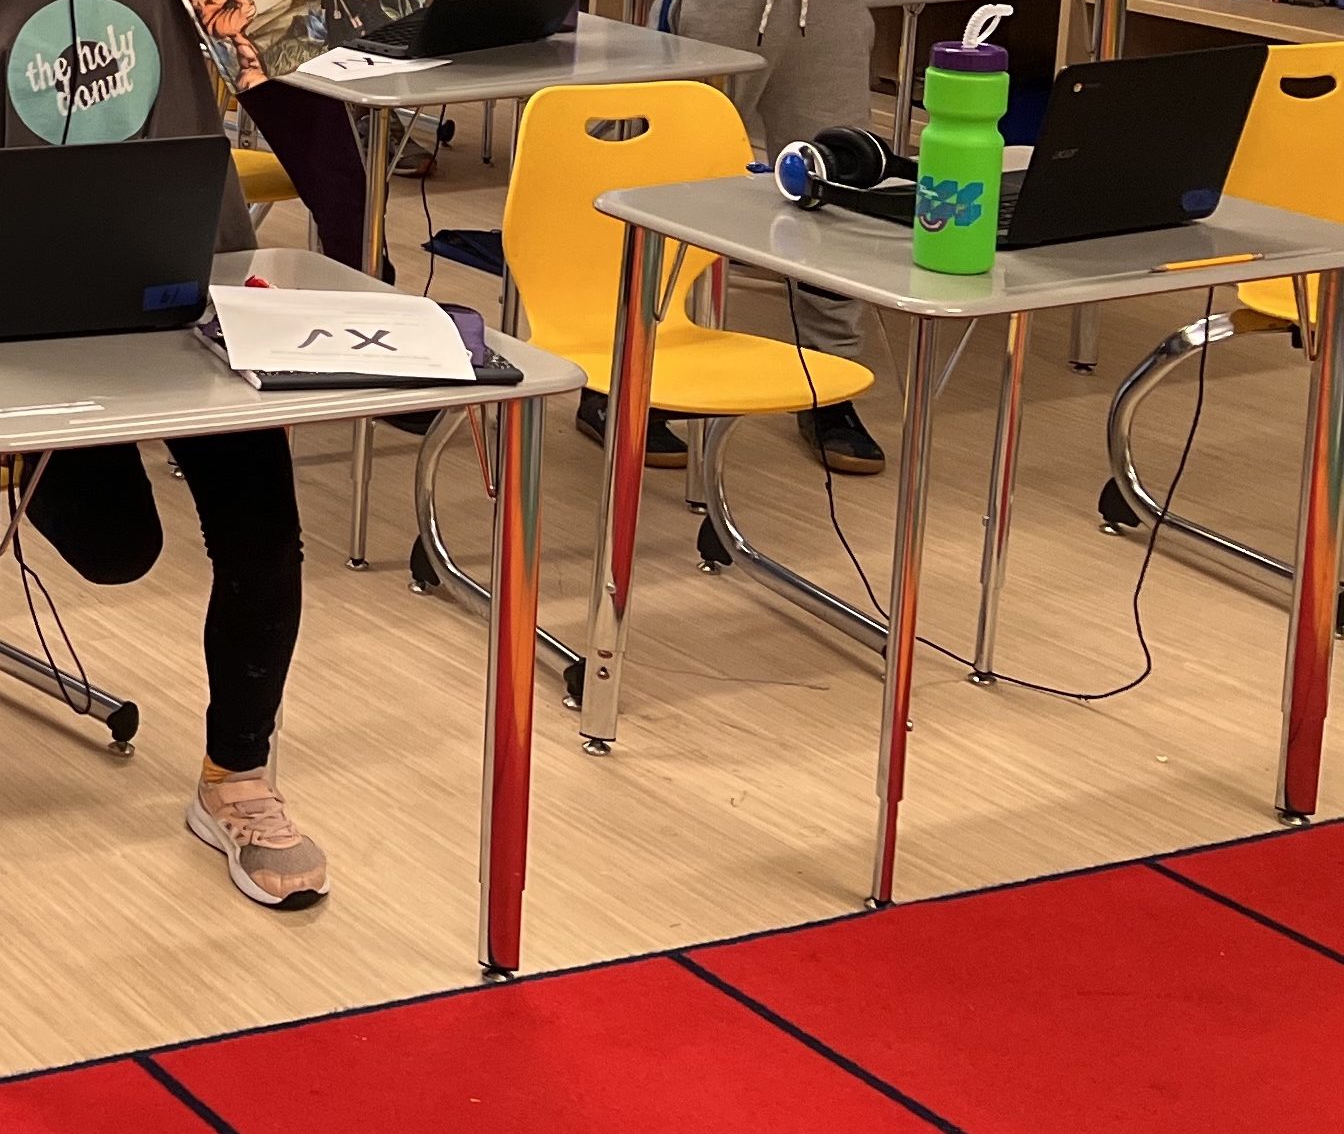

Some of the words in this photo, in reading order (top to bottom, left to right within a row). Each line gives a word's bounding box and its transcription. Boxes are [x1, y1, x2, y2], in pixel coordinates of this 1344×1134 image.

[25, 53, 71, 93] the
[76, 25, 136, 75] holy
[56, 56, 134, 116] donut
